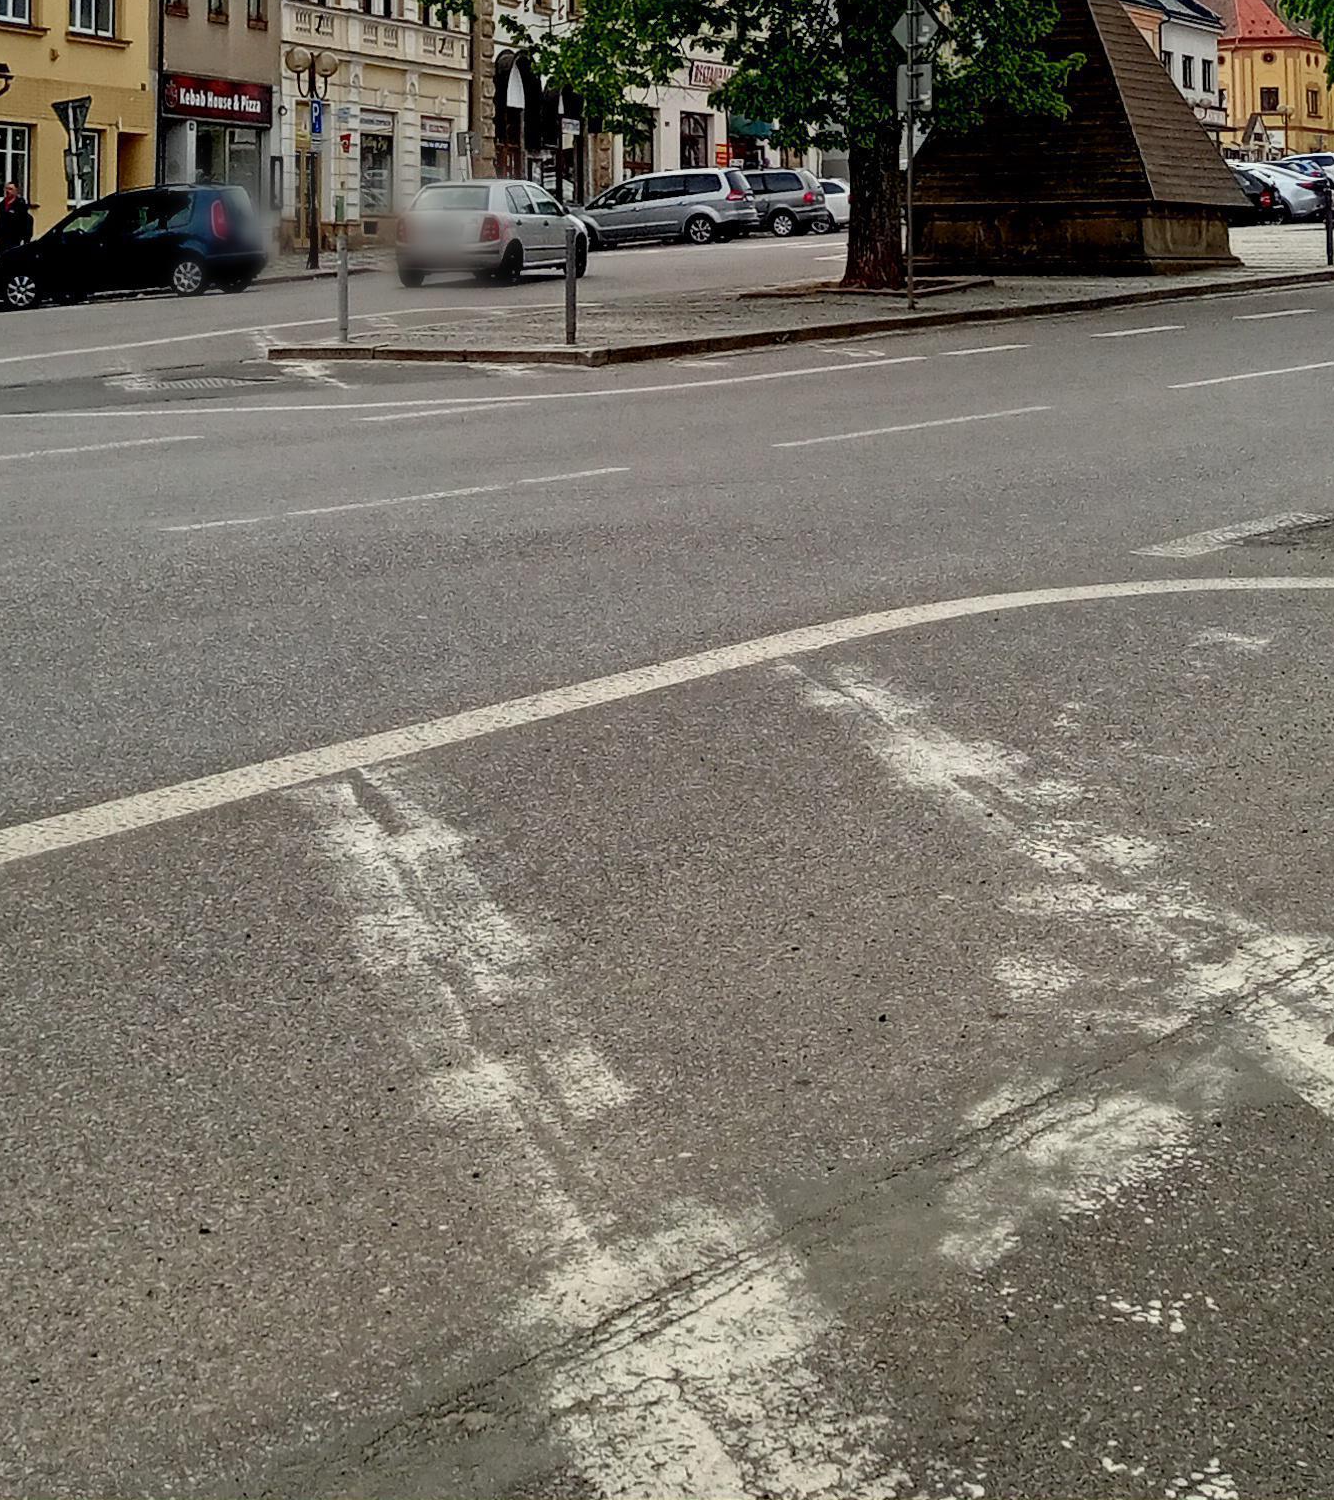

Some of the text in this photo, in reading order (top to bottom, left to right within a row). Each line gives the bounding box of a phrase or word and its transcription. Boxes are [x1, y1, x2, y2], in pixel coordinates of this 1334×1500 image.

[179, 87, 261, 113] Kebab House & Pizza
[312, 103, 320, 124] P
